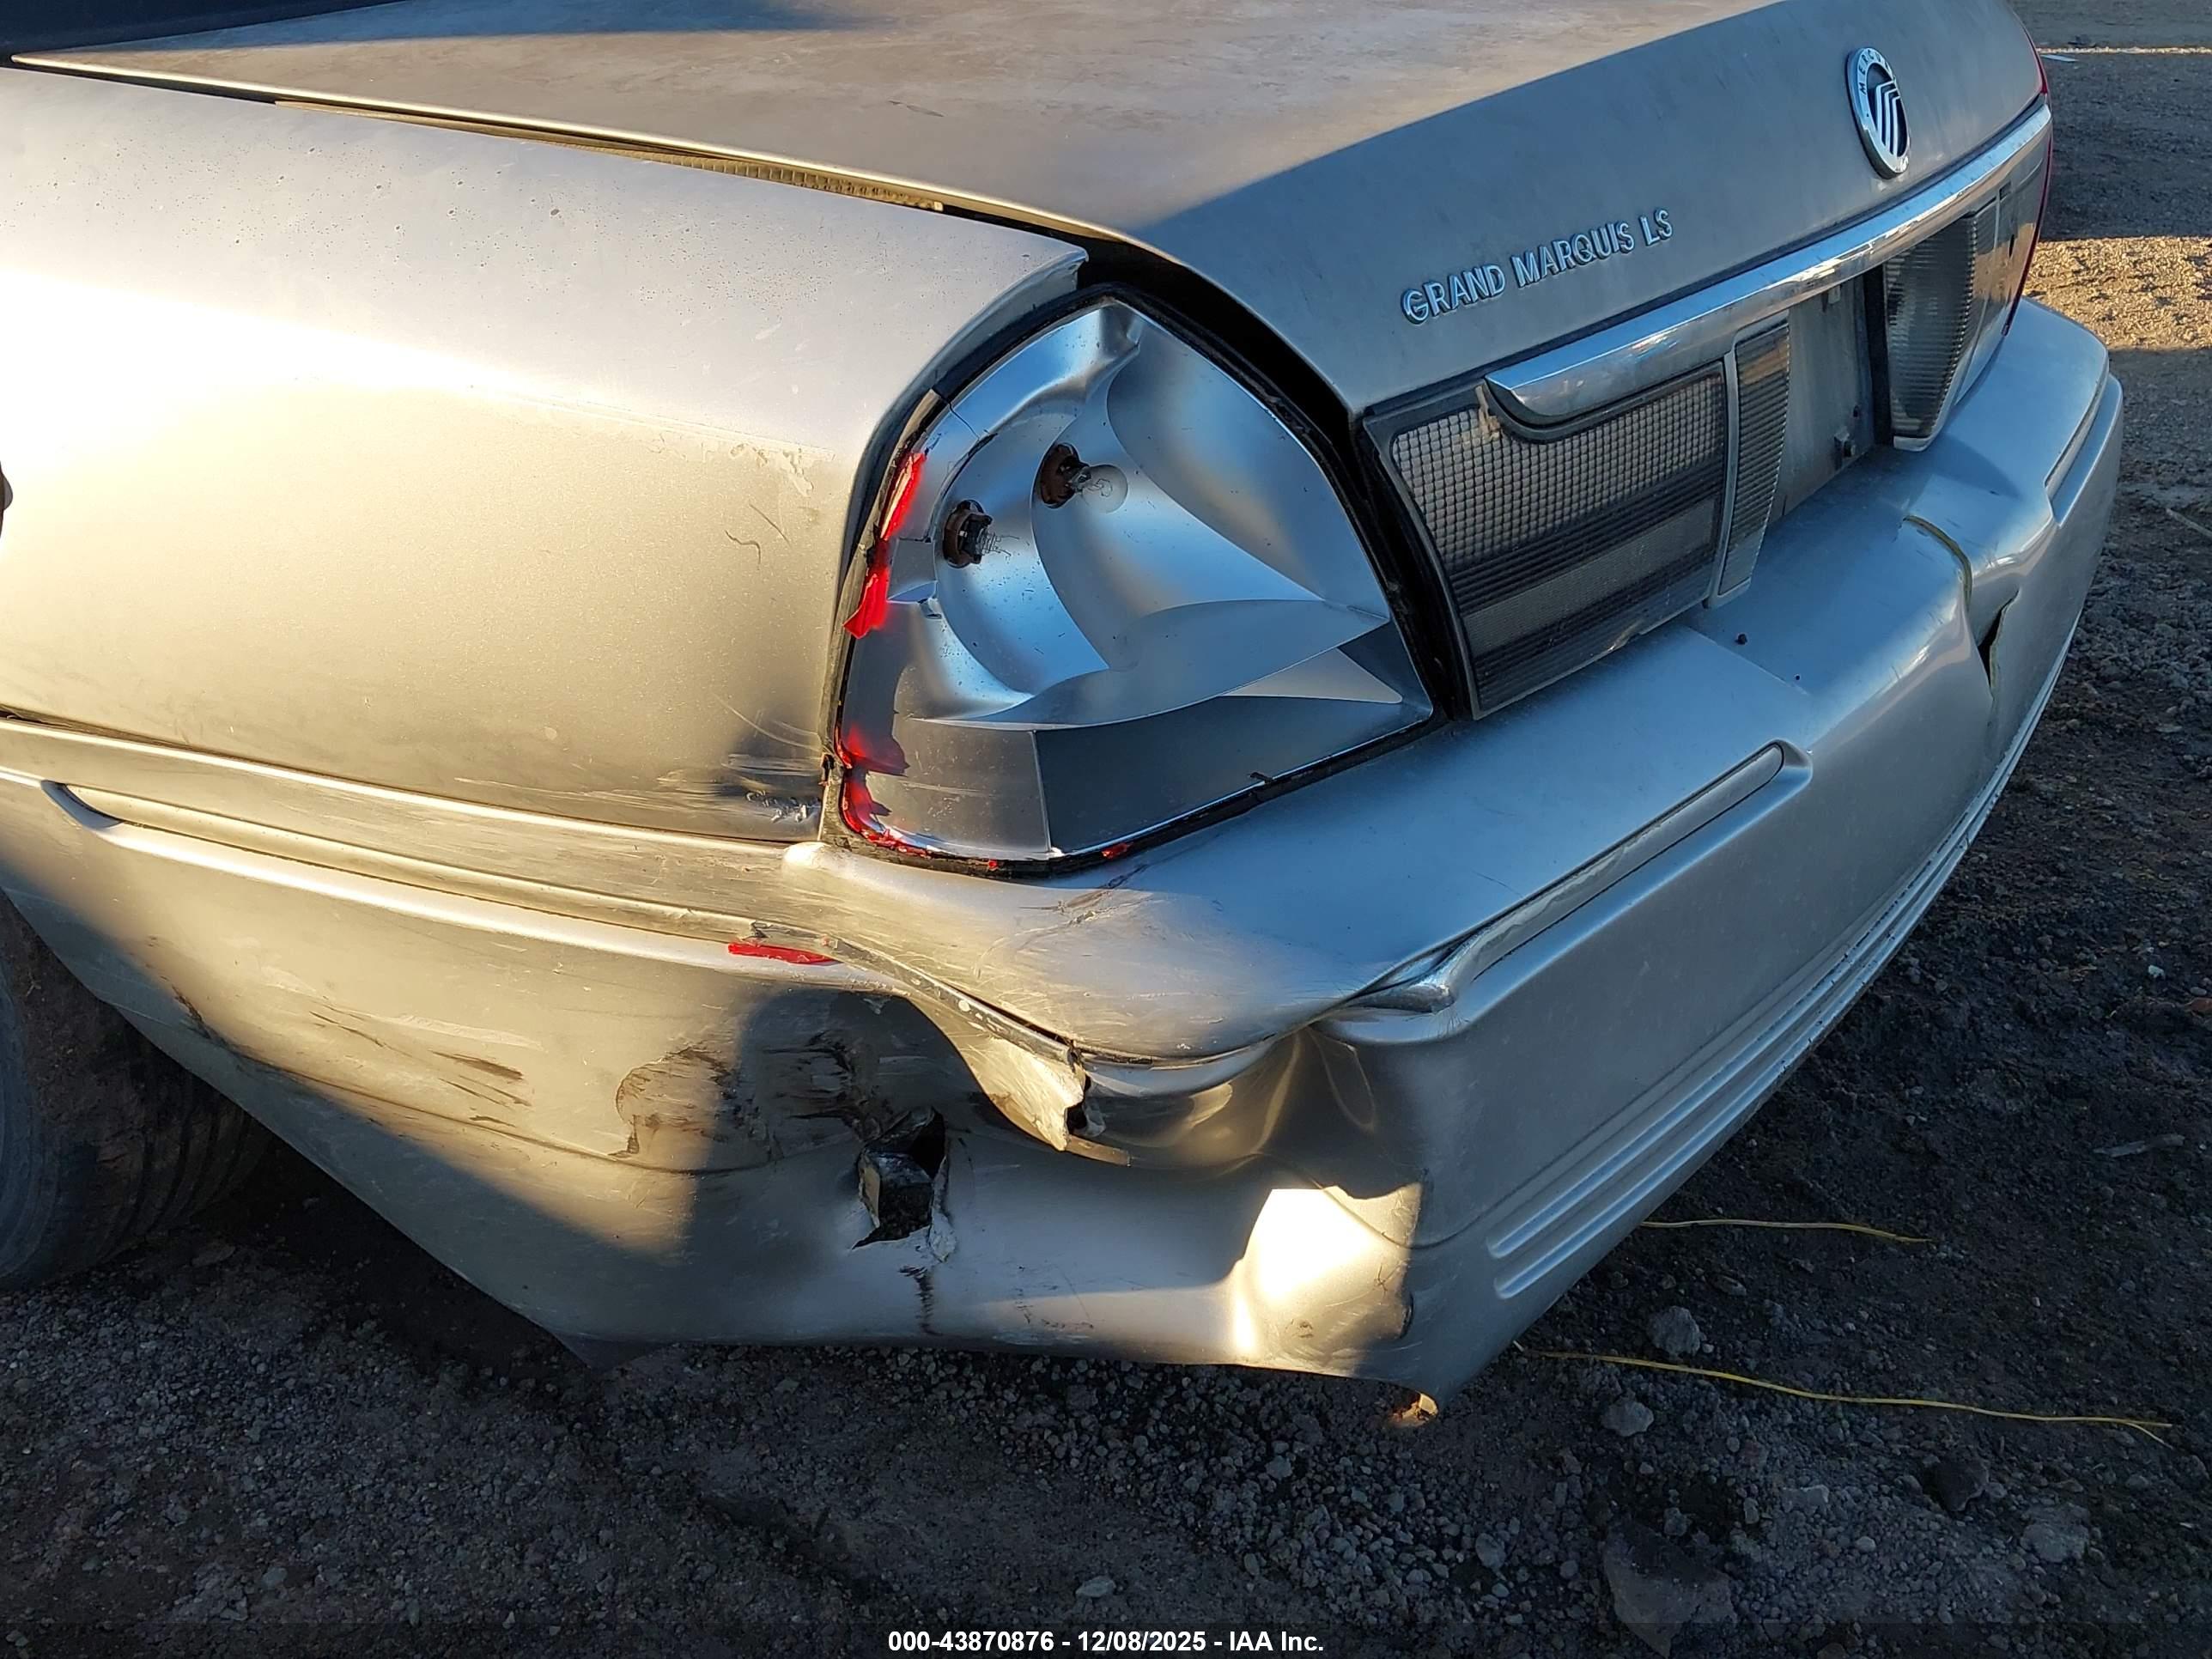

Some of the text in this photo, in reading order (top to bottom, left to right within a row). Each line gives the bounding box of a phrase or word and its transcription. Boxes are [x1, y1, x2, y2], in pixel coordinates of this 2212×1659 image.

[1401, 209, 1674, 324] GRAND MARQUIS LS
